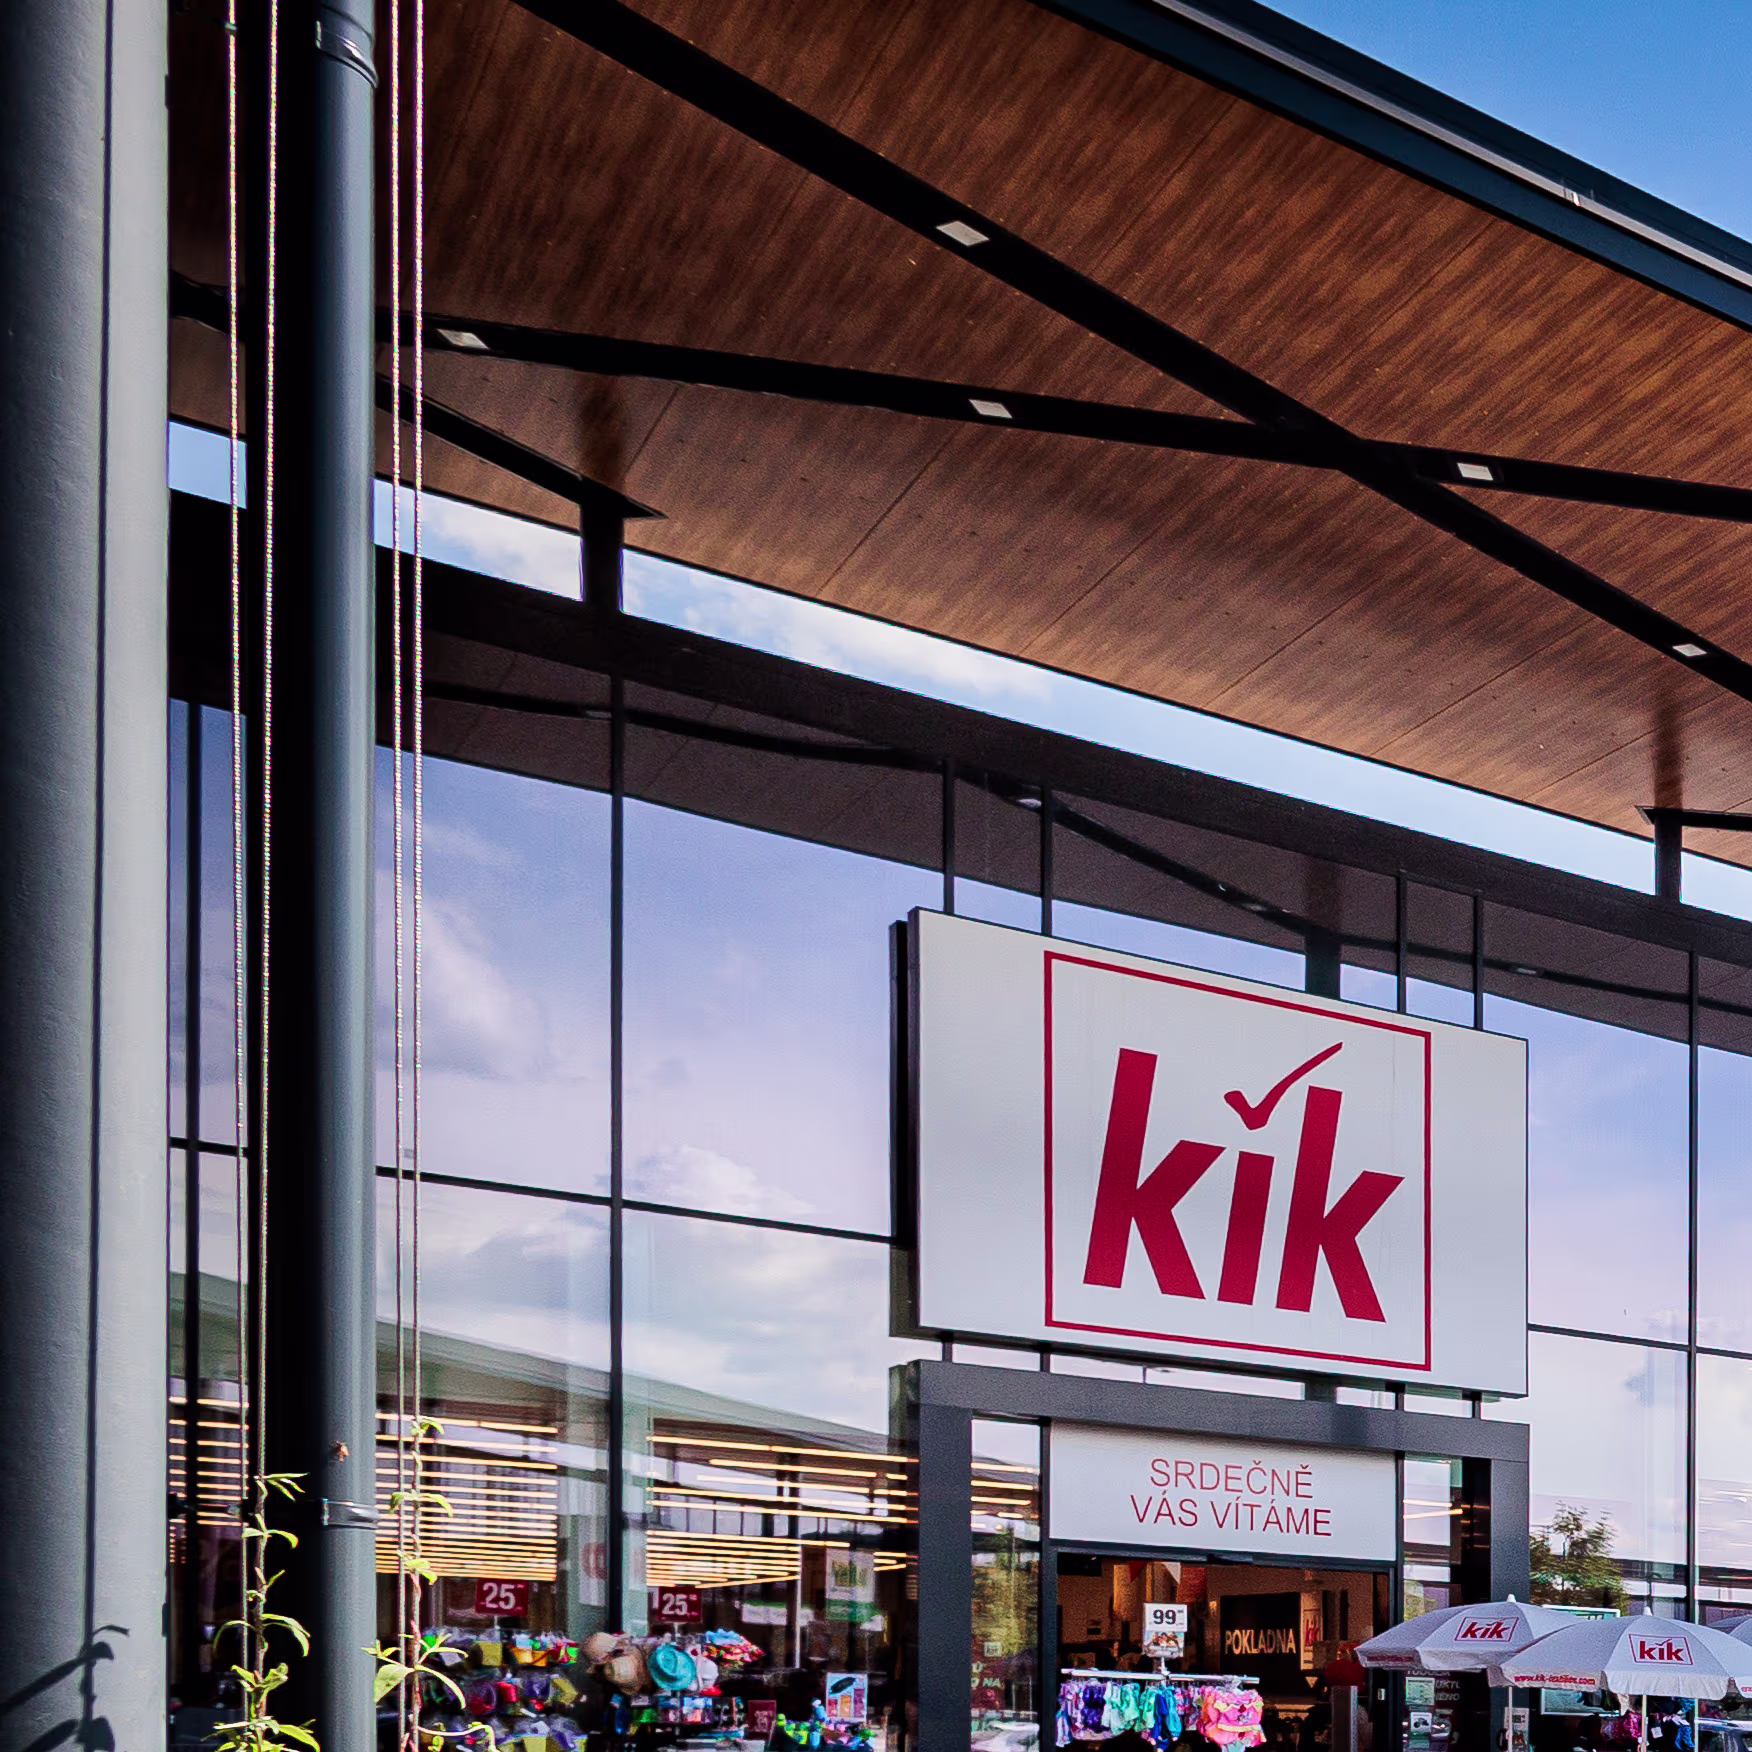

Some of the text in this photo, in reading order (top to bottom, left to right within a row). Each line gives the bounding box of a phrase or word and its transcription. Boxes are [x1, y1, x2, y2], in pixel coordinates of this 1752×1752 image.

[1083, 1042, 1405, 1323] kik
[1149, 1457, 1313, 1498] SRDEČNĚ
[1129, 1495, 1333, 1538] VÁS VÍTÁME
[482, 1581, 516, 1610] 25
[662, 1593, 688, 1616] 25
[1153, 1609, 1177, 1625] 99
[1461, 1618, 1510, 1639] kik
[1224, 1628, 1297, 1655] POKLADNA
[1638, 1637, 1685, 1662] kik
